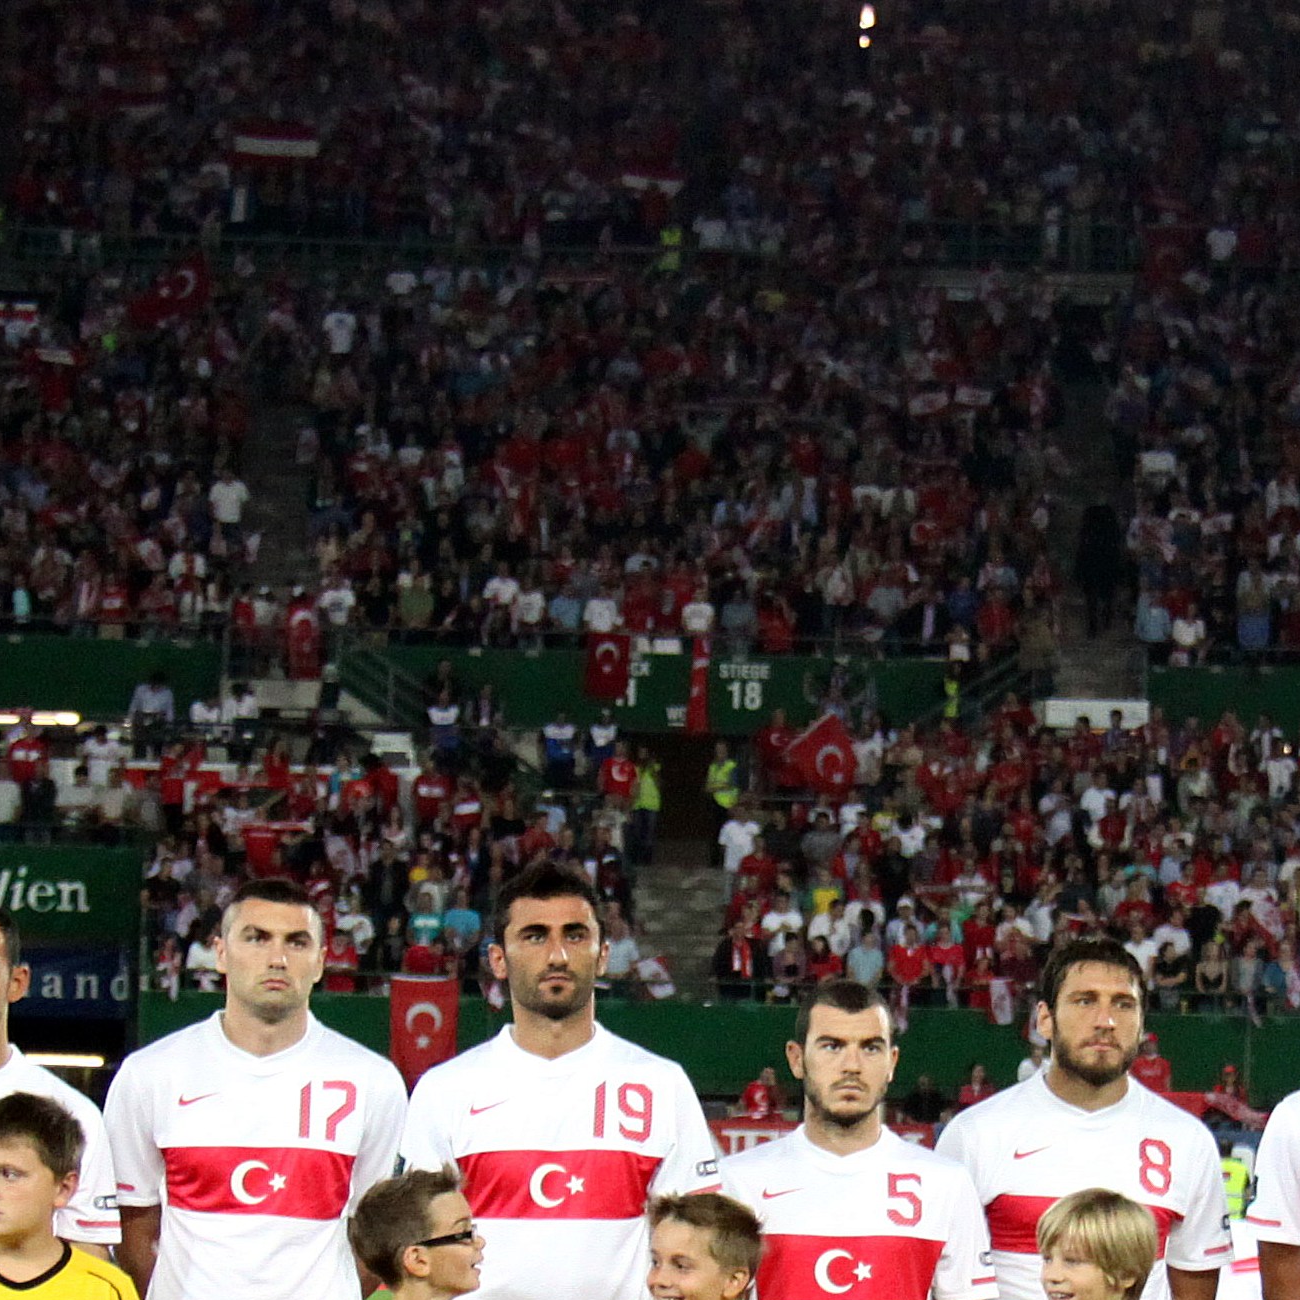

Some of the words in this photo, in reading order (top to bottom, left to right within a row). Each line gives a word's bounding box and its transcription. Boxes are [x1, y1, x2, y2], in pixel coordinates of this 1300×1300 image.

[719, 663, 770, 680] STIEGE
[726, 680, 763, 711] 18
[300, 1080, 357, 1142] 17
[593, 1081, 653, 1143] 19
[1138, 1137, 1172, 1196] 8
[887, 1172, 923, 1226] 5
